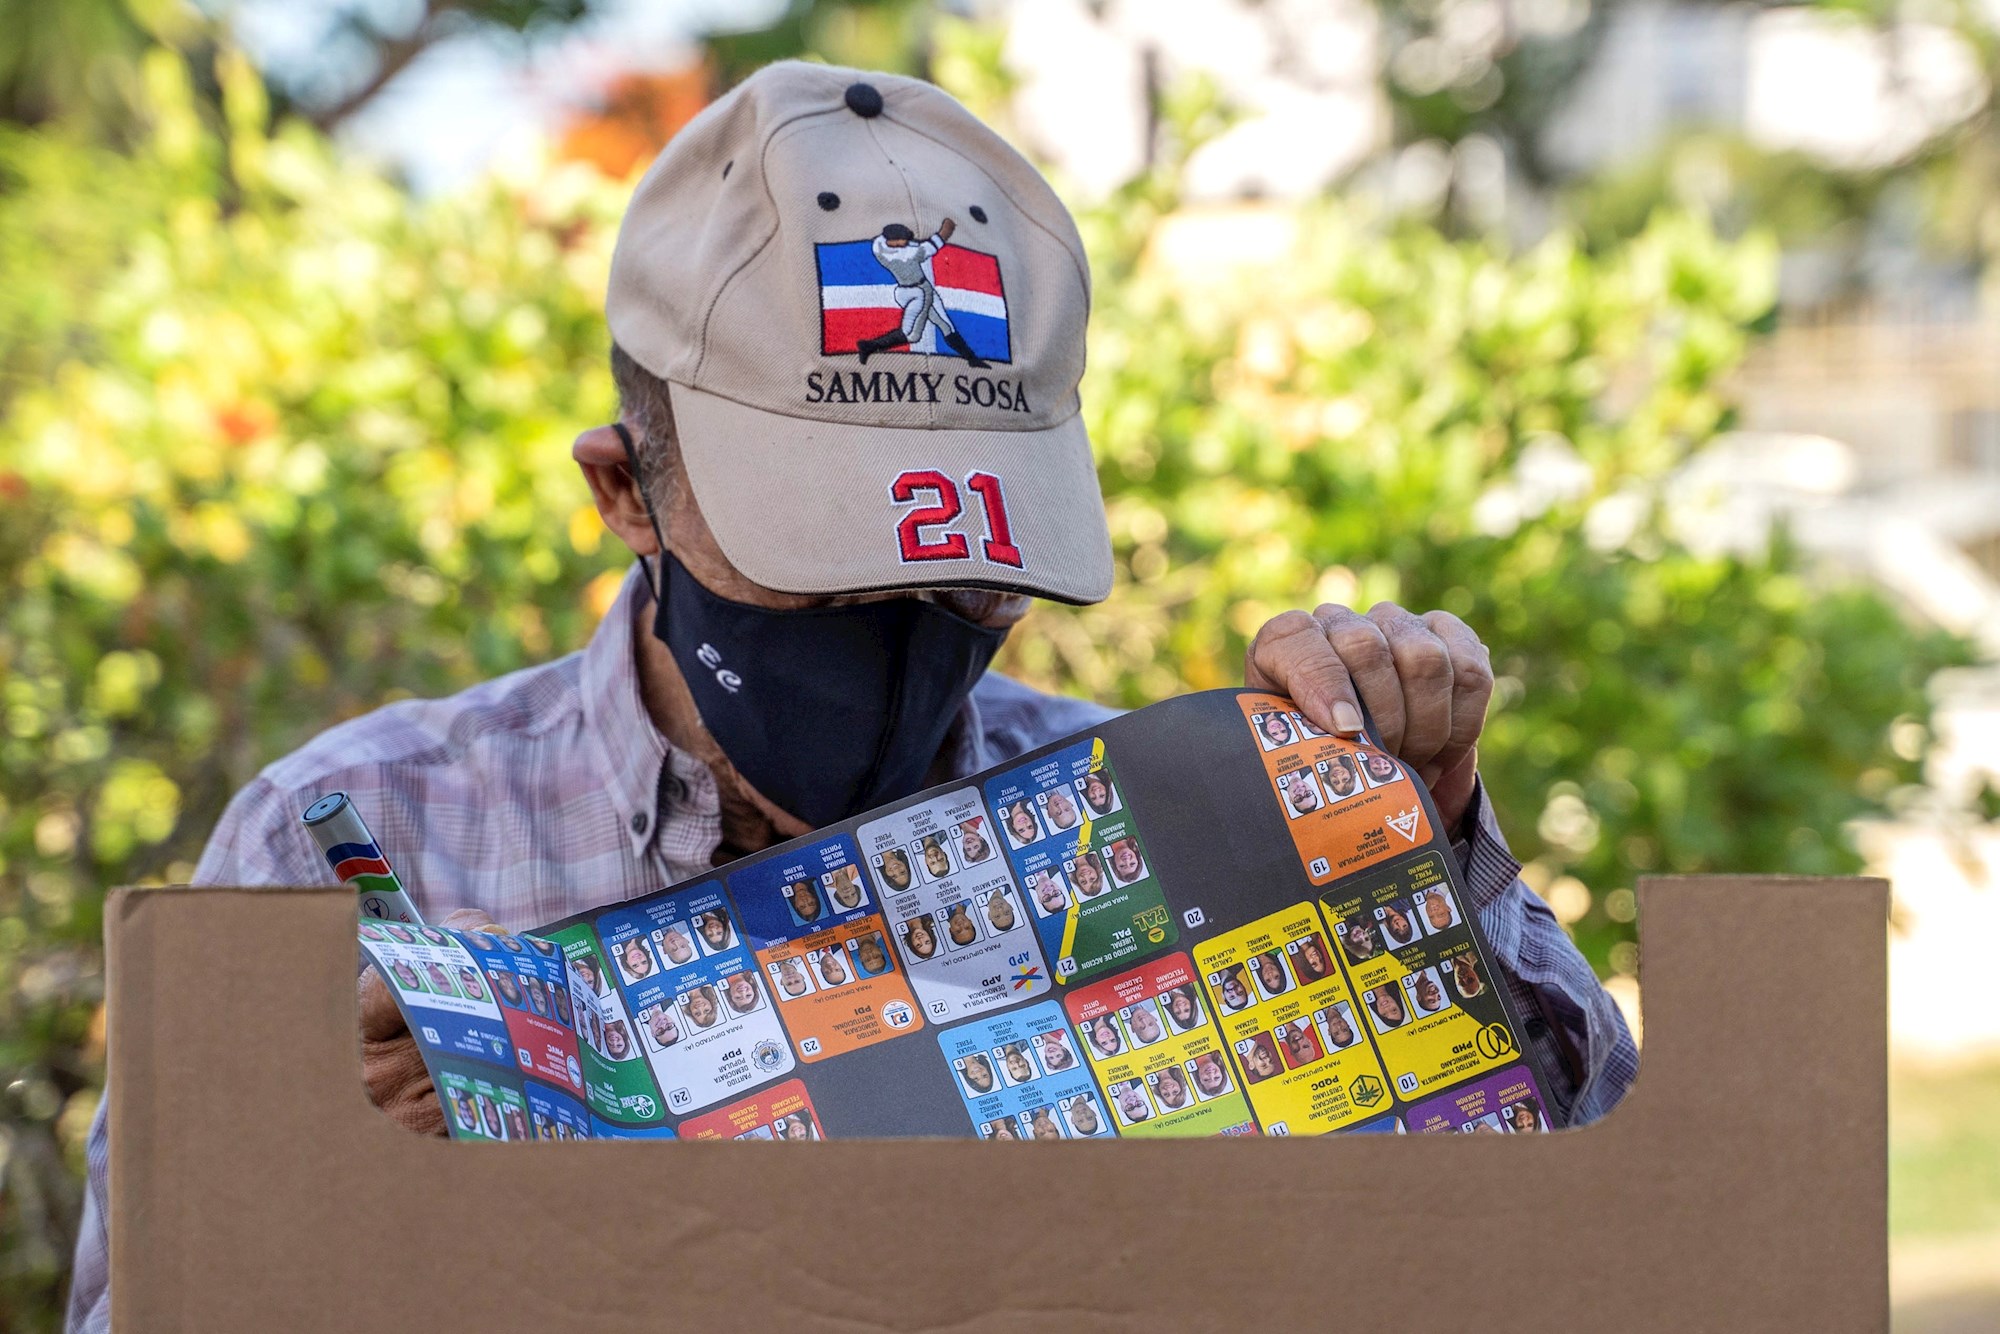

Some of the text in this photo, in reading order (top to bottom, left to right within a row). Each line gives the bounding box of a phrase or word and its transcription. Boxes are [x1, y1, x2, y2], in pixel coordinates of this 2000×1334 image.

[806, 371, 1031, 413] SAMMY SOSA
[888, 468, 1027, 572] 21
[1030, 761, 1058, 776] CALDERON
[997, 790, 1024, 804] MICHELLE
[1000, 785, 1016, 795] ORTIZ
[944, 800, 975, 816] CONTRERAS
[1332, 793, 1381, 815] PARA DIPUTADO
[906, 808, 932, 822] VILLEGAS
[954, 810, 970, 820] DIANA
[912, 823, 937, 836] ORLANDO
[913, 817, 931, 828] JORGE
[1098, 821, 1125, 836] ABINADER
[874, 832, 891, 842] PEREZ
[1103, 829, 1125, 842] SANDRA
[1362, 826, 1383, 840] PPC
[819, 843, 841, 854] PORTES
[1355, 835, 1387, 851] CRISTIANO
[1024, 852, 1046, 864] MENDEZ
[1337, 843, 1389, 867] PARTIDO POPULAR
[1024, 858, 1051, 872] GRAYMER
[1312, 860, 1327, 873] 19
[1410, 873, 1441, 889] FRANCISCO
[1414, 869, 1432, 880] PEREZ
[971, 875, 1006, 892] ELIAS MATOS
[935, 884, 960, 898] VASQUEZ
[939, 892, 961, 904] MIGUEL
[688, 892, 716, 907] FELICIANO
[689, 898, 721, 914] MARGARITA
[896, 899, 920, 912] RAMIREZ
[1081, 894, 1128, 915] PARA DIPUTADO
[901, 907, 919, 918] LAURA
[1133, 907, 1168, 932] PAL
[1187, 911, 1200, 923] 20
[614, 922, 631, 932] ORTIZ
[1281, 917, 1311, 932] MERCEDES
[1287, 925, 1311, 937] MASSIEL
[611, 927, 639, 941] MICHELLE
[1112, 927, 1131, 940] PAL
[1245, 934, 1270, 947] RAMIREZ
[1110, 936, 1134, 949] LIBERAL
[1248, 940, 1272, 953] MARISOL
[952, 942, 1001, 963] PARA DIPUTADO
[1112, 943, 1137, 957] PARTIDO
[1201, 947, 1236, 964] VILLAR BAEZ
[714, 955, 741, 970] ABINADER
[1007, 951, 1030, 967] APD
[1060, 960, 1073, 972] 21
[1081, 956, 1103, 969] ACCION
[1211, 957, 1232, 968] CARLOS
[719, 963, 742, 975] SANDRA
[1155, 968, 1184, 983] FELICIANO
[1359, 966, 1386, 980] SANTIAGO
[674, 975, 707, 991] JACQUELINE
[680, 972, 696, 982] ORTIZ
[981, 974, 1002, 987] APD
[1113, 975, 1142, 991] CALDERON
[1156, 974, 1188, 990] MARGARITA
[1363, 973, 1388, 986] LOURDES
[637, 986, 660, 999] MENDEZ
[824, 983, 871, 1002] PARA DIPUTADO
[968, 982, 1005, 1001] DEMOCRACIA
[983, 990, 1008, 1004] ALIANZA
[1308, 985, 1340, 1001] FERNANDEZ
[638, 992, 664, 1006] GRAYMER
[971, 998, 983, 1006] POR
[1082, 999, 1099, 1010] ORTIZ
[1318, 994, 1335, 1005] OMAR
[853, 1004, 871, 1015] PDI
[931, 1001, 945, 1014] 22
[1079, 1004, 1107, 1018] MICHELLE
[1271, 1001, 1299, 1016] GONZALEZ
[832, 1013, 874, 1031] INSTITUCIONAL
[890, 1011, 909, 1025] PDI
[1275, 1009, 1300, 1021] HOMERO
[1417, 1010, 1464, 1032] PARA DIPUTADO
[843, 1020, 877, 1036] DEMOCRATA
[1234, 1018, 1258, 1030] GUZMAN
[1238, 1025, 1258, 1036] MISAEL
[694, 1024, 743, 1046] PARA DIPUTADO
[856, 1027, 881, 1039] PARTIDO
[803, 1040, 817, 1051] 23
[1182, 1035, 1210, 1050] ABINADER
[1187, 1043, 1210, 1055] SANDRA
[1451, 1040, 1472, 1053] PHD
[720, 1048, 741, 1060] PDP
[1148, 1052, 1165, 1062] ORTIZ
[1440, 1051, 1477, 1068] DOMINICANO
[717, 1057, 745, 1072] POPULAR
[1107, 1063, 1129, 1075] MENDEZ
[1143, 1055, 1175, 1071] JACQUELINE
[1291, 1059, 1340, 1081] PARA DIPUTADO
[713, 1065, 748, 1082] DEMOCRATA
[1108, 1068, 1133, 1082] GRAYMER
[1420, 1058, 1479, 1085] PARTIDO HUMANISTA
[726, 1072, 751, 1086] PARTIDO
[1310, 1075, 1339, 1090] PQDC
[1400, 1076, 1415, 1088] 10
[673, 1090, 687, 1103] 24
[1311, 1085, 1343, 1101] CRISTIANO
[1310, 1093, 1346, 1109] DEMOCRATA
[1164, 1106, 1211, 1127] PARA DIPUTADO
[1307, 1100, 1349, 1119] QUISQUEYANO
[1327, 1108, 1352, 1121] PARTIDO
[1272, 1124, 1286, 1137] 11
